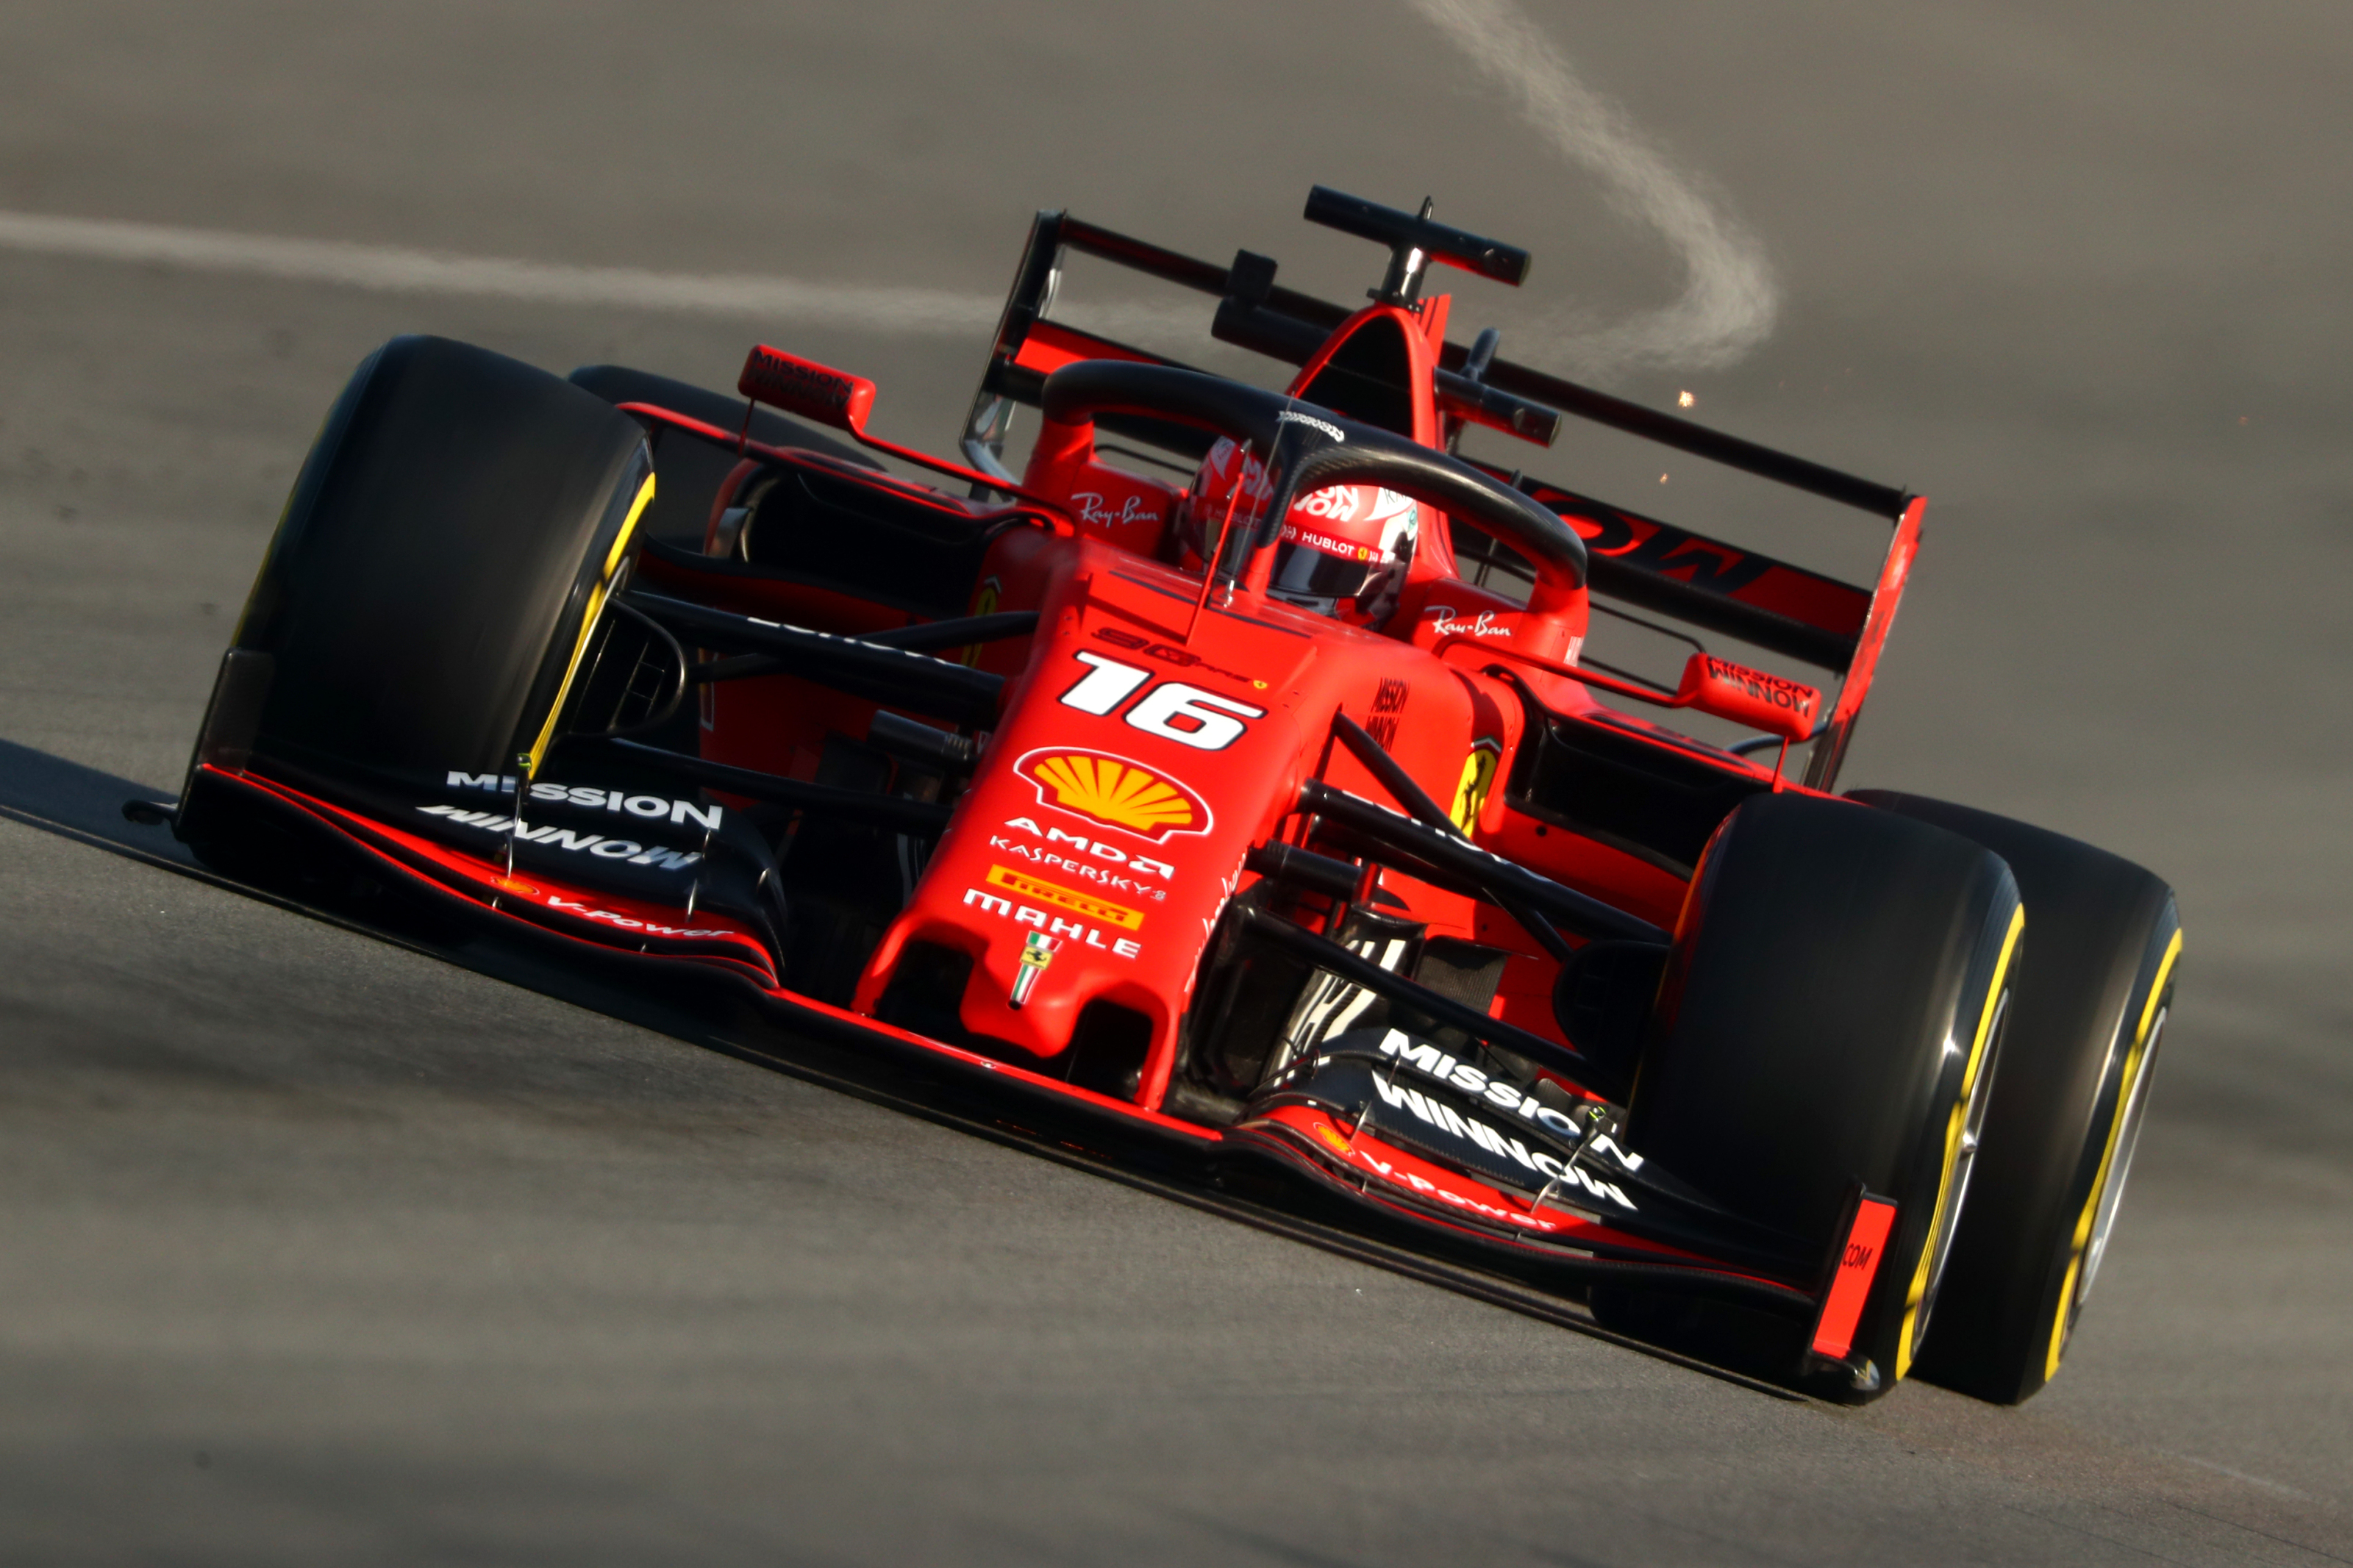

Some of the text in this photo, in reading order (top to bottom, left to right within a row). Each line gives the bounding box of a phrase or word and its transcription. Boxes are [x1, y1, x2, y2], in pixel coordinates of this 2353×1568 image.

[753, 349, 854, 395] MISSION
[1071, 493, 1159, 528] Ray-Ban
[1302, 531, 1354, 556] HUBLOT
[1424, 605, 1511, 637] Ray-Ban
[1057, 648, 1268, 751] 16
[446, 770, 724, 831] MISSION
[415, 803, 703, 870] WINNOW
[990, 834, 1152, 895] KASPERSKY
[547, 895, 735, 937] V-Power
[962, 887, 1143, 959] MAHLE
[1001, 872, 1129, 923] PIRELLI
[1379, 1028, 1644, 1172] MISSION
[1371, 1069, 1639, 1211] WINNOW
[1359, 1149, 1557, 1230] V-Power
